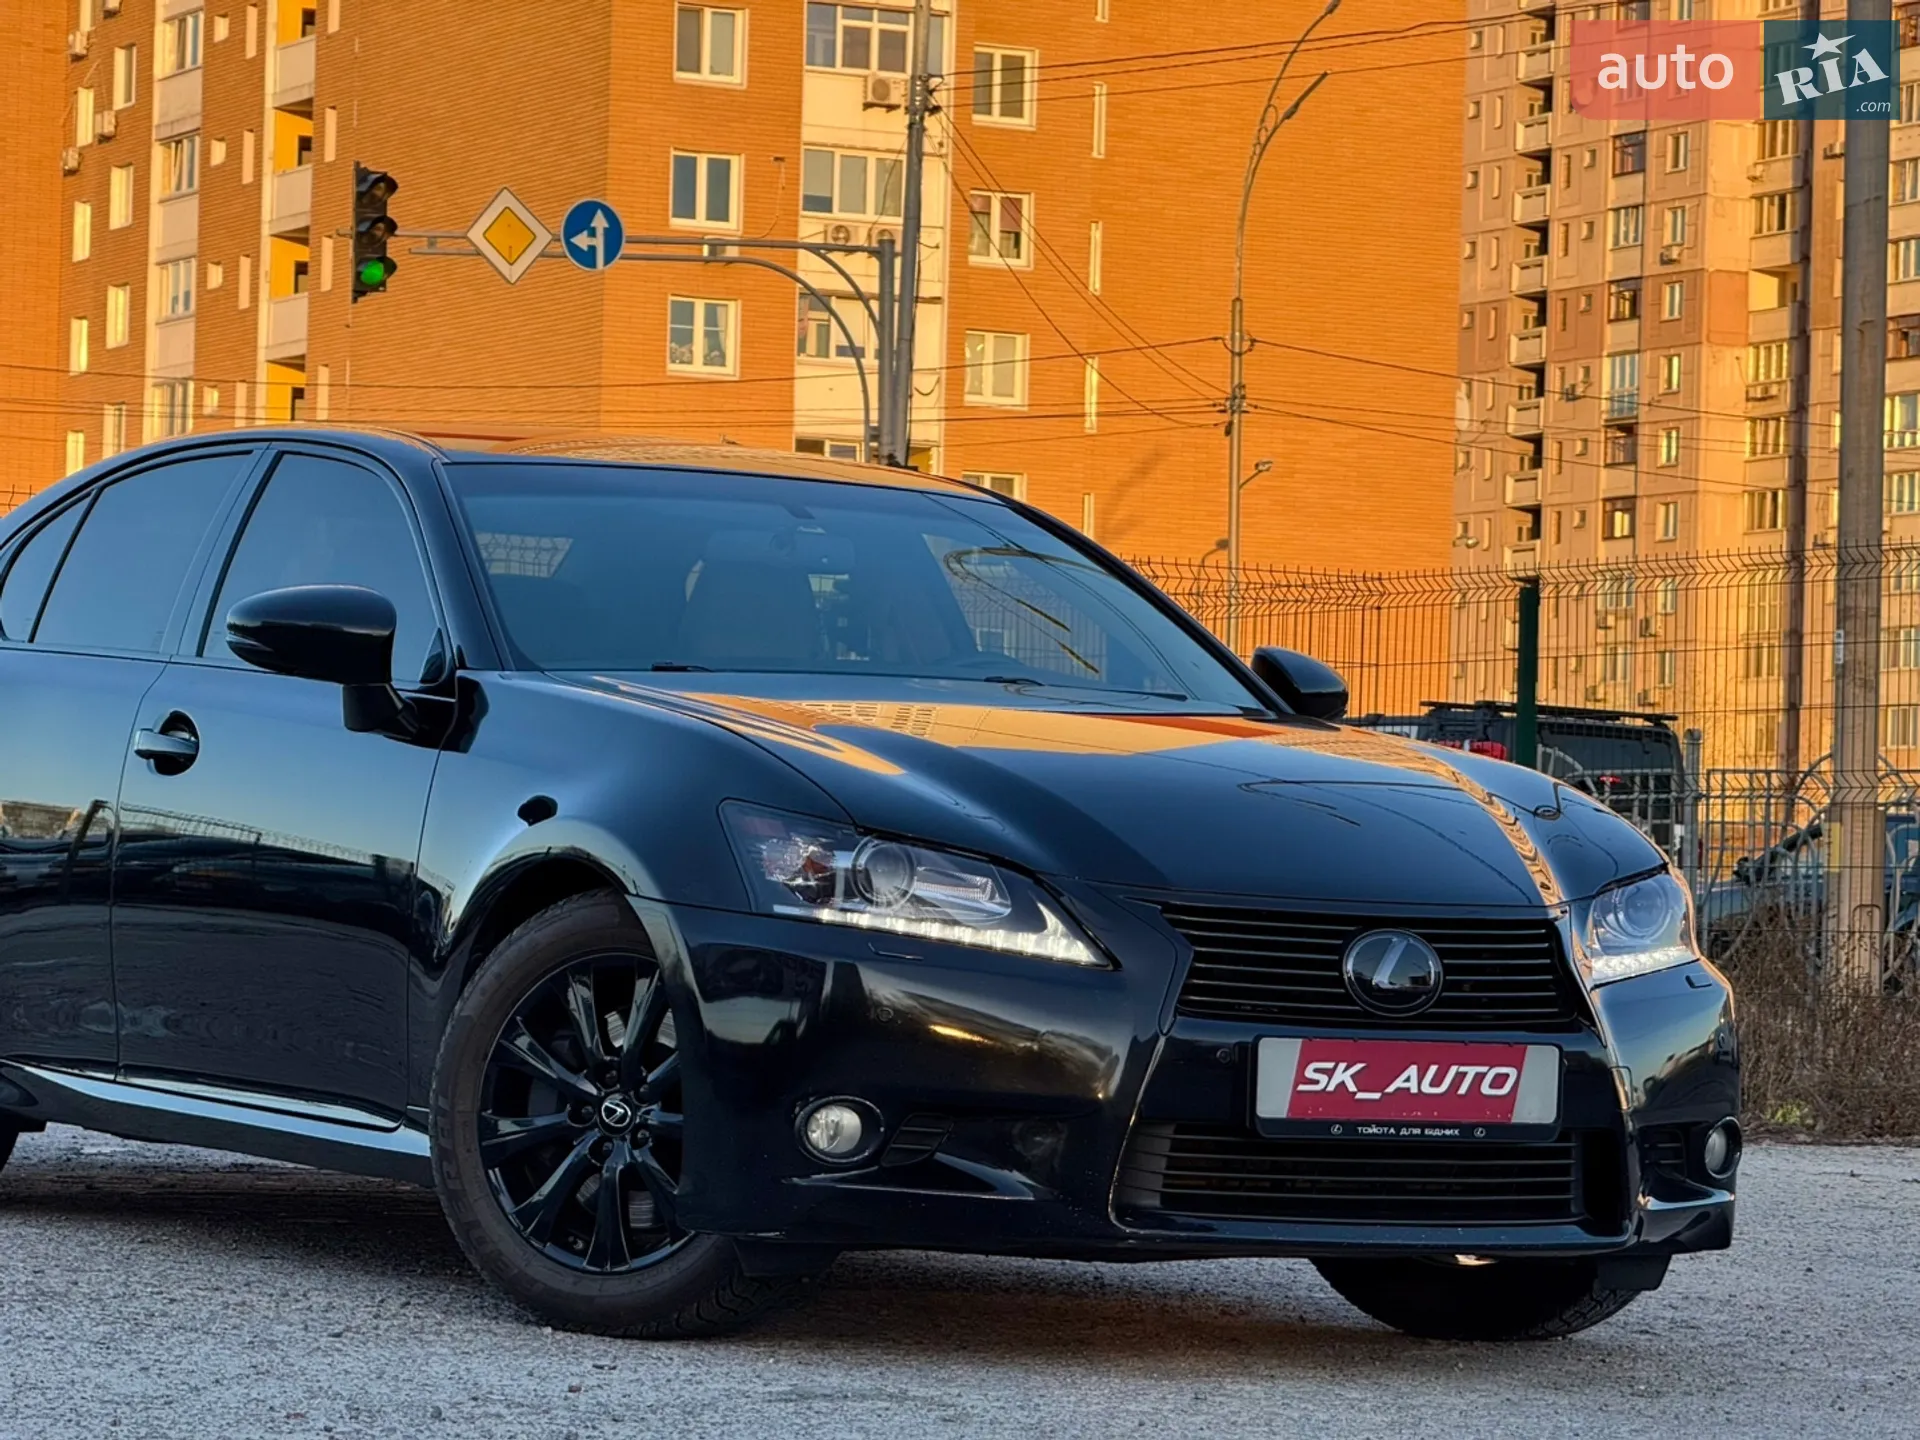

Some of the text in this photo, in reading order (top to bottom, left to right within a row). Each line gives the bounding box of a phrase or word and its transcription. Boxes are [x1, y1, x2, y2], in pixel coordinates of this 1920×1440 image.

[1296, 1062, 1518, 1100] SK_AUTO
[1356, 1124, 1396, 1135] ТОЙОТА
[1400, 1126, 1422, 1136] ДЛЯ
